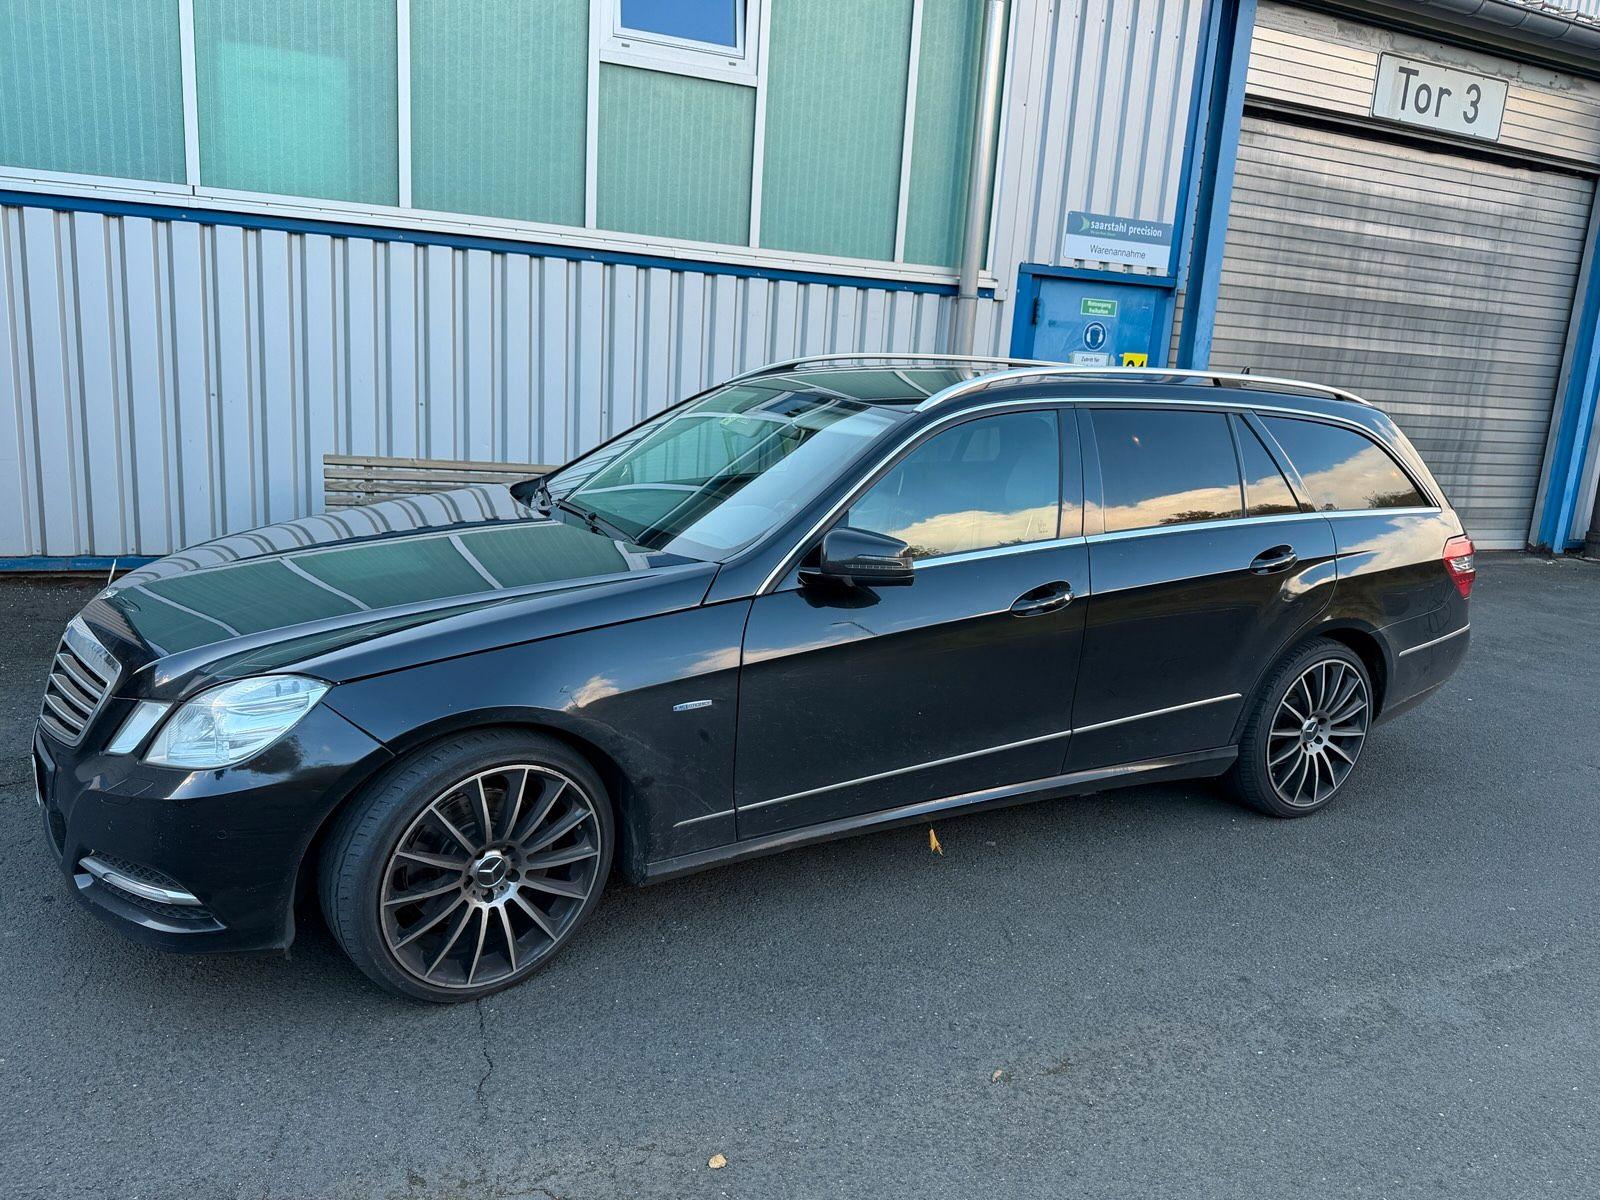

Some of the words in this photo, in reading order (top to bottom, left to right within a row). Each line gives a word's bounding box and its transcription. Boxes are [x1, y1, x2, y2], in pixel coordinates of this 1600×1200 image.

[1398, 66, 1452, 117] Tor
[1463, 83, 1481, 124] 3
[1090, 220, 1127, 233] saarstahl
[1128, 226, 1162, 238] precision
[1090, 244, 1146, 259] Warenannahme
